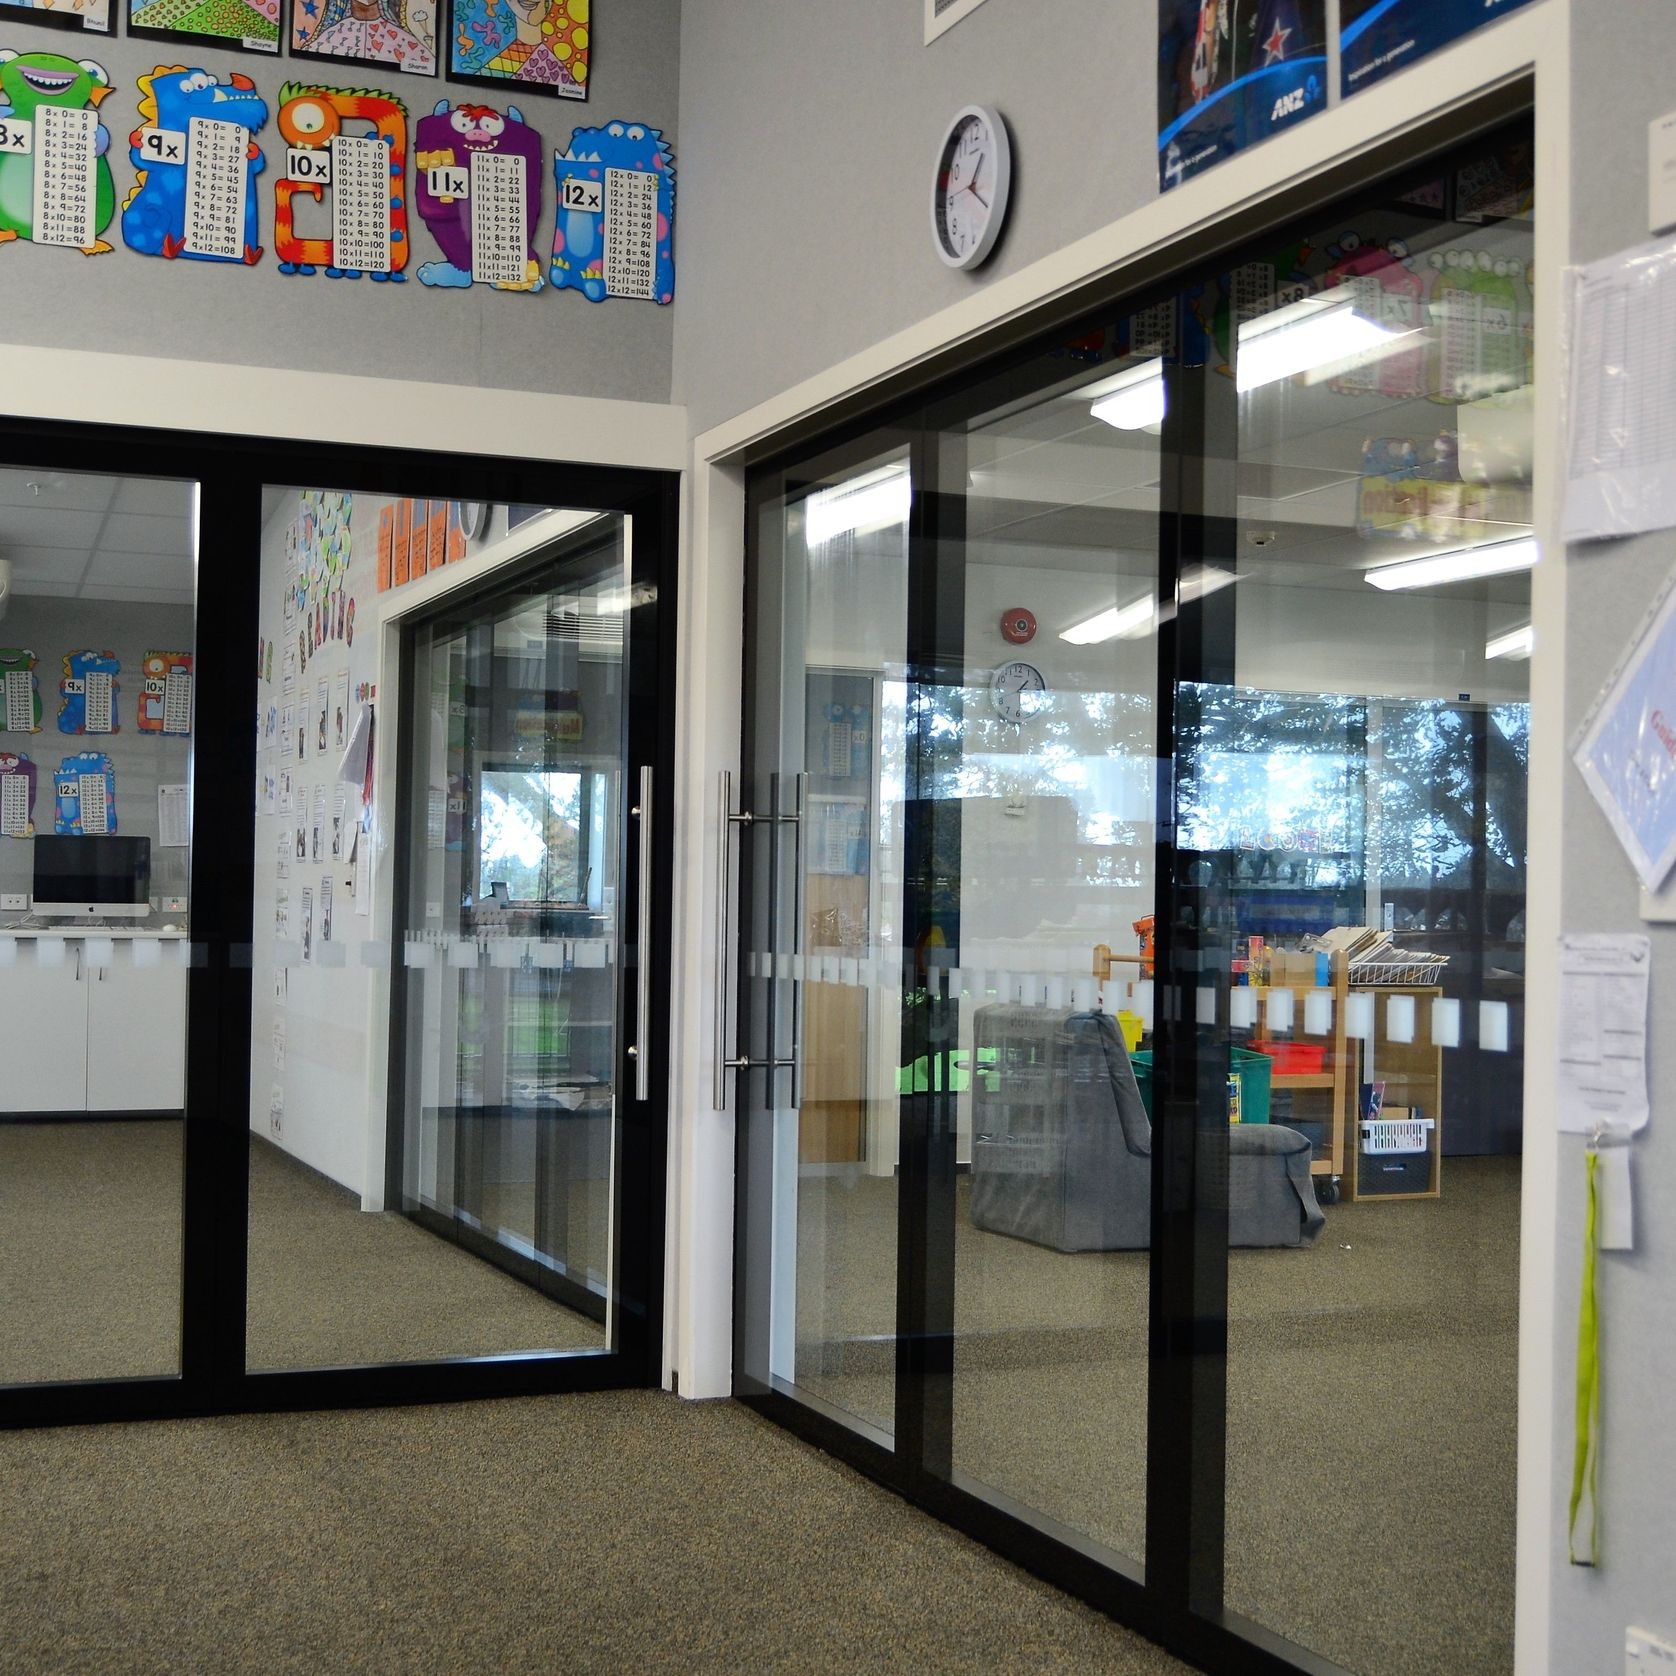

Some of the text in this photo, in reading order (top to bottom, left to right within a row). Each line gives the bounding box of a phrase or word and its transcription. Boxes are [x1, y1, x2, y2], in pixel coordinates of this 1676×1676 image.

[1271, 88, 1304, 121] ANZ
[148, 134, 178, 158] 9x
[290, 154, 327, 178] 10x
[432, 171, 464, 194] 11x
[566, 184, 599, 207] 12x
